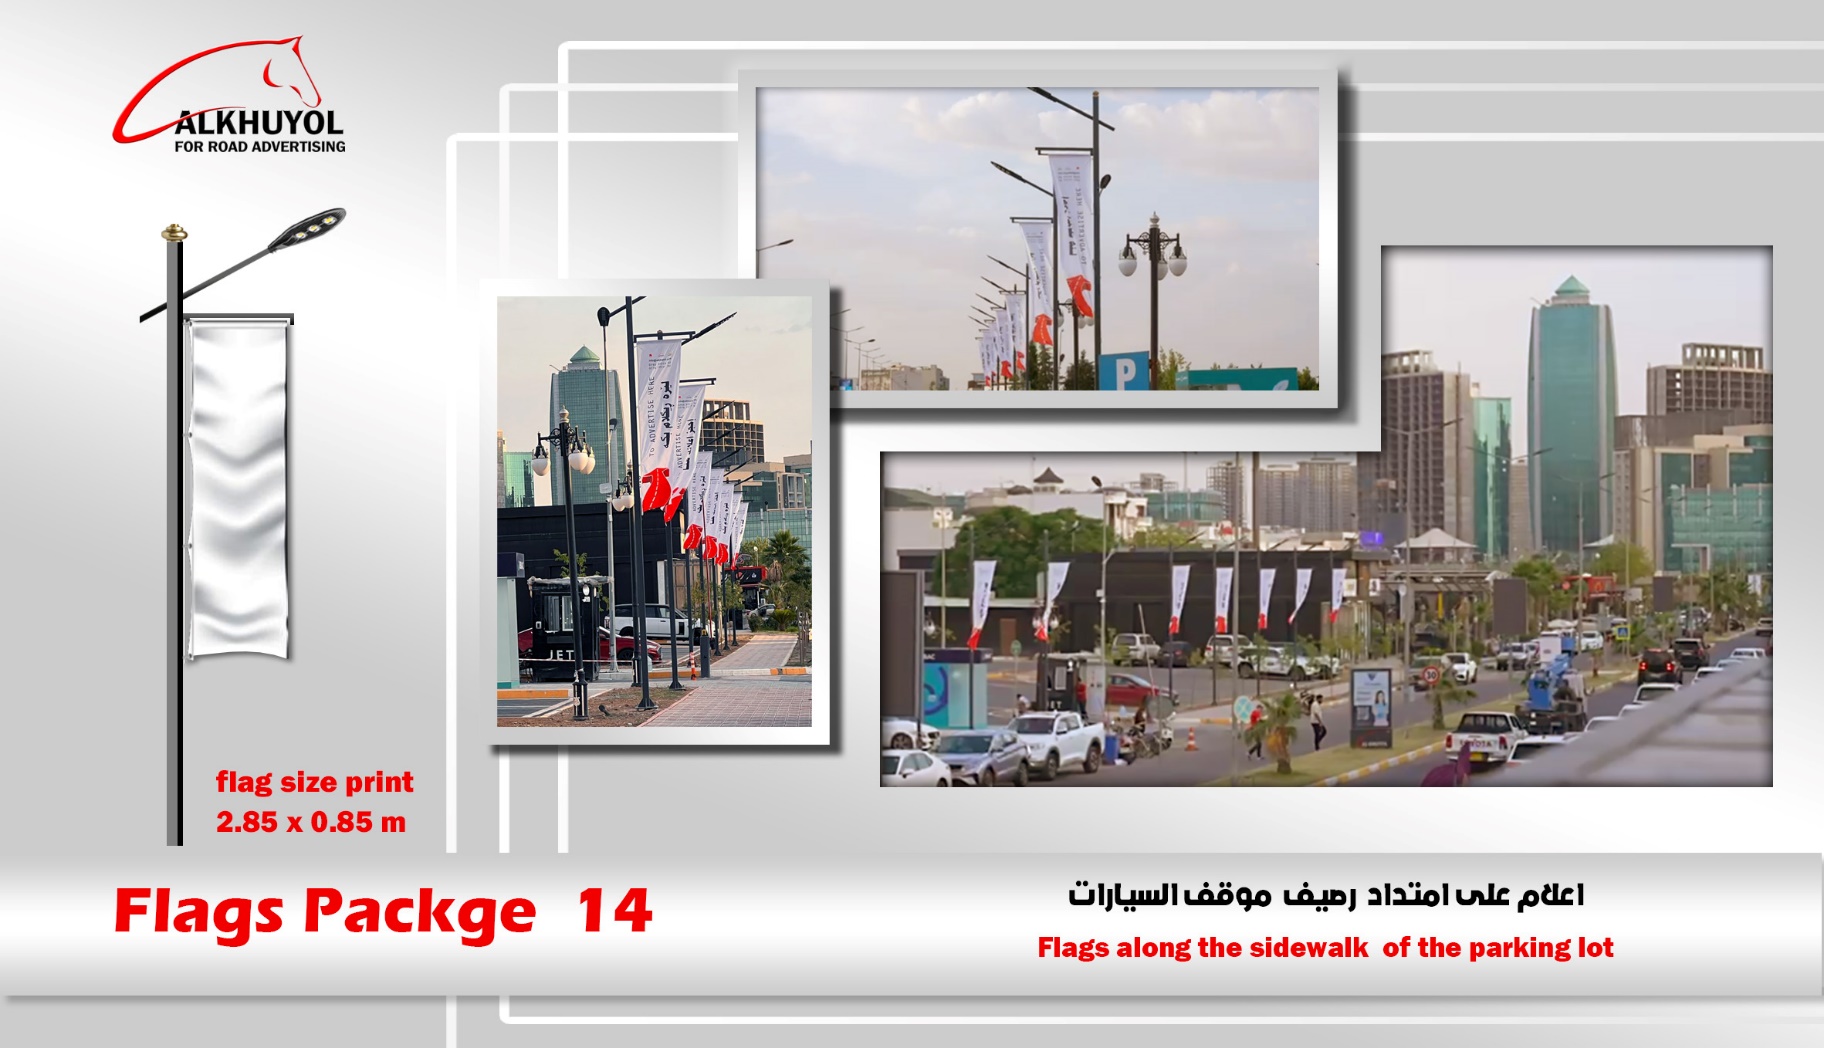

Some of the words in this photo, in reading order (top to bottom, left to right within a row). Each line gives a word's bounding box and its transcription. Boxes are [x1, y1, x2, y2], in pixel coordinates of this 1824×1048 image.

[1116, 358, 1137, 390] P
[647, 399, 656, 443] ADVERTISE
[546, 649, 574, 660] JET
